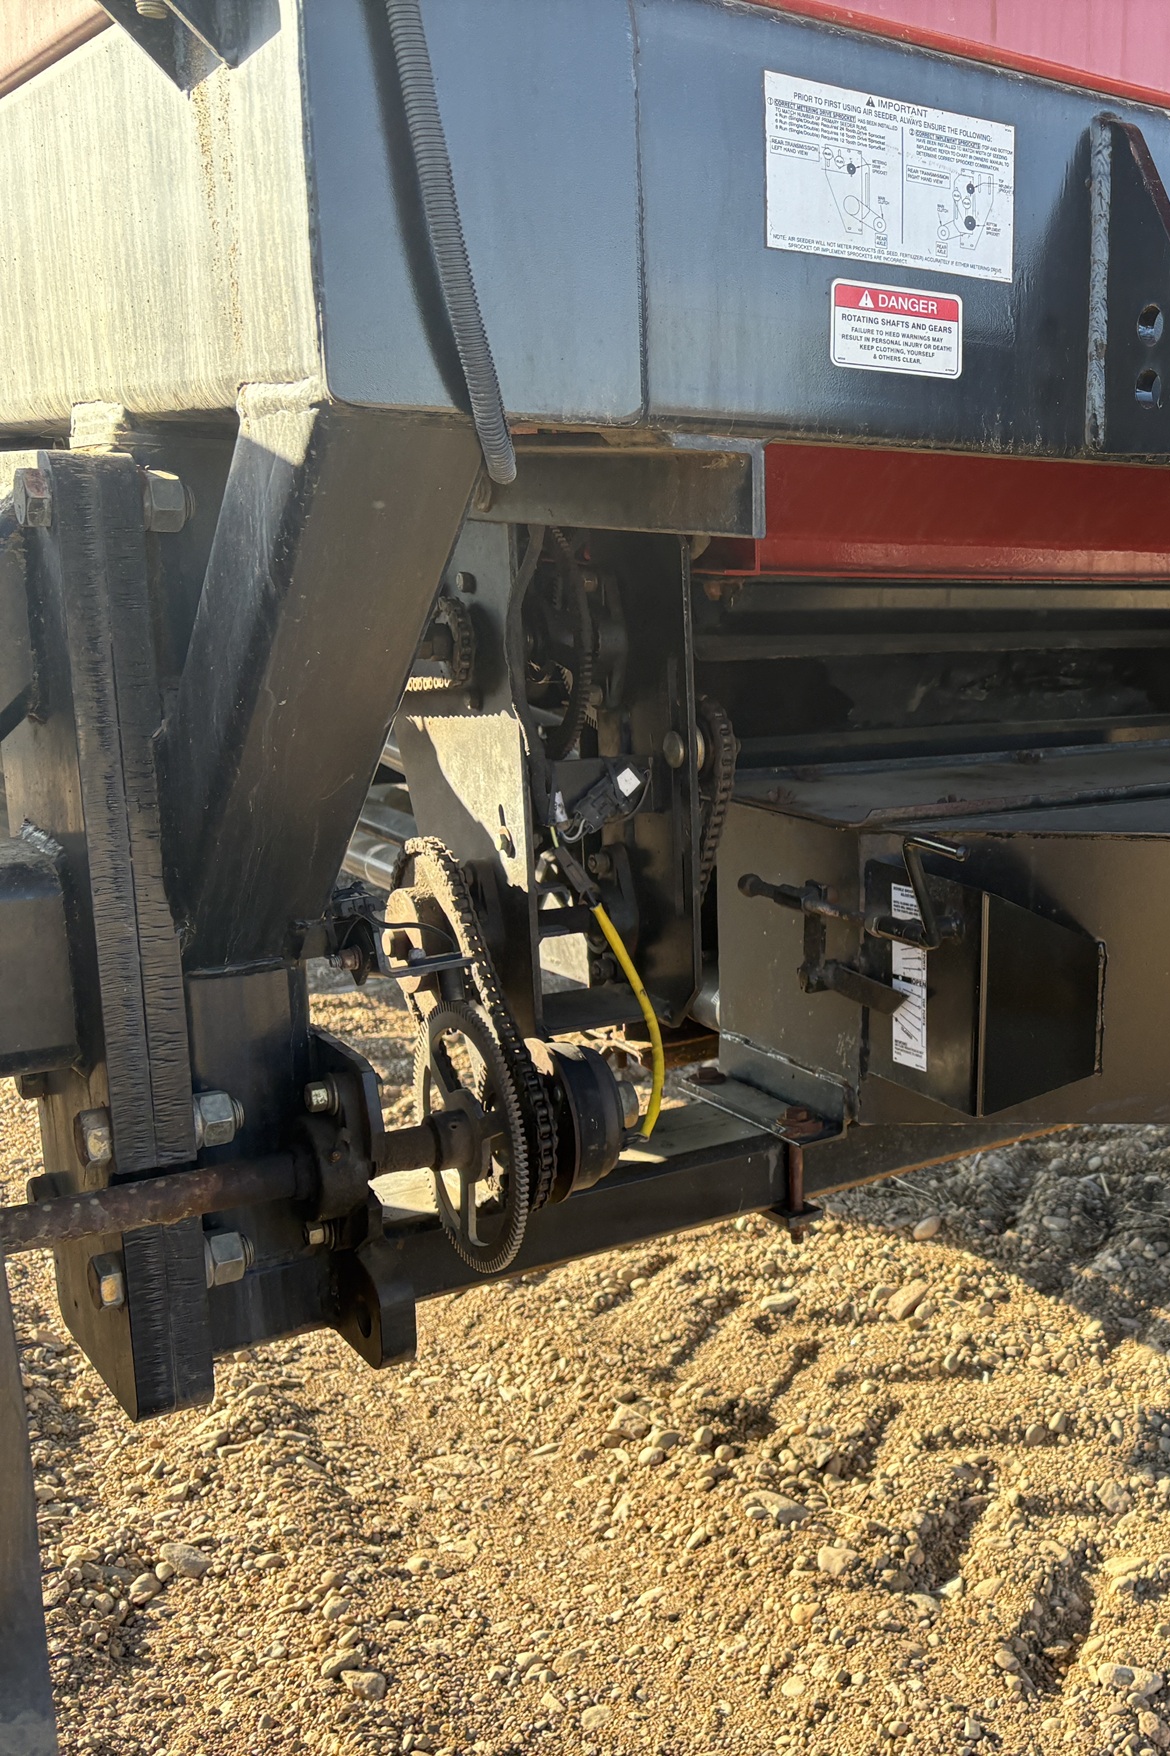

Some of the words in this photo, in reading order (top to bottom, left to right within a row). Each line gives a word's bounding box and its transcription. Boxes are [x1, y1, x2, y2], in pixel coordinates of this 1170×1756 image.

[774, 99, 795, 110] CORRECT
[858, 116, 866, 125] HAS
[867, 118, 877, 127] BEEN
[878, 121, 898, 132] INSTALLED
[794, 92, 812, 103] PRIOR
[814, 96, 823, 106] TO
[824, 98, 841, 109] FIRST
[843, 103, 861, 114] USING
[863, 107, 872, 116] AIR
[874, 110, 898, 122] SEEDER,
[900, 115, 922, 127] ALWAYS
[924, 121, 946, 132] ENSURE
[948, 126, 958, 135] THE
[959, 128, 992, 142] FOLLOWING:
[878, 99, 927, 118] IMPORTANT
[788, 242, 812, 251] SPROCKET
[821, 247, 846, 256] IMPLEMENT
[847, 251, 873, 260] SPROCKETS
[853, 245, 876, 253] PRODUCTS
[925, 256, 949, 265] ACCURATELY
[879, 294, 937, 314] DANGER
[842, 313, 879, 325] ROTATING
[881, 318, 910, 329] SHAFTS
[912, 322, 927, 331] AND
[929, 324, 952, 334] GEARS
[841, 333, 863, 342] RESULT
[872, 337, 901, 346] PERSONAL
[903, 341, 922, 349] INJURY
[852, 327, 874, 335] FAILURE
[901, 333, 930, 342] WARNINGS
[876, 346, 906, 355] CLOTHING,
[907, 349, 935, 358] YOURSELF
[878, 354, 901, 362] OTHERS
[911, 978, 927, 987] OPEN
